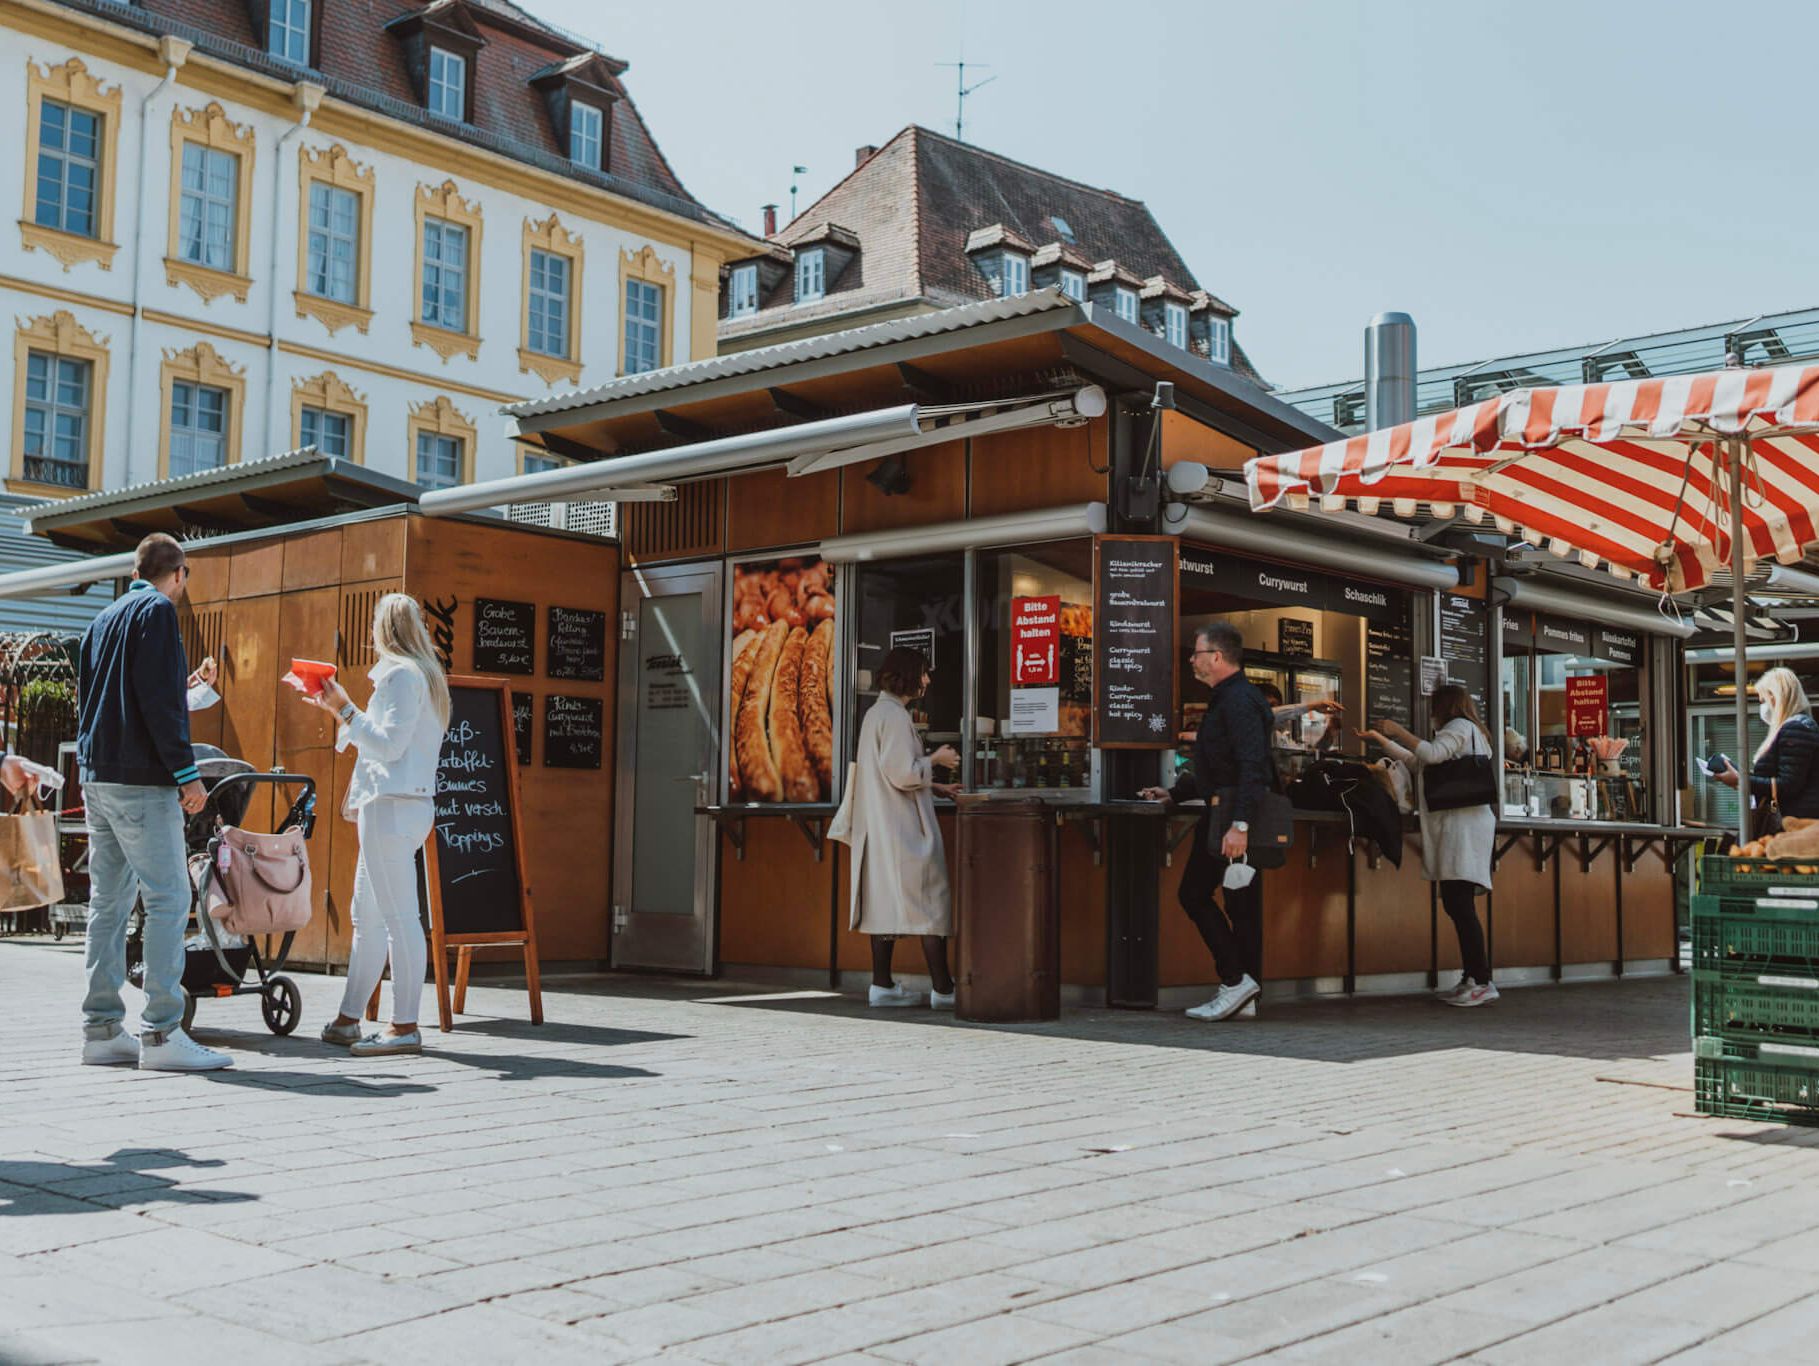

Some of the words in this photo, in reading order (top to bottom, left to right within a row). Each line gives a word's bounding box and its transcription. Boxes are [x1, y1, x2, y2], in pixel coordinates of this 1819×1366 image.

[1259, 572, 1308, 593] Currywurst
[1345, 587, 1387, 606] Schaschlik
[1024, 602, 1048, 613] Bitte
[1016, 613, 1056, 626] Abstand
[1503, 617, 1519, 631] Fries
[1020, 628, 1051, 638] halten
[1544, 624, 1569, 641] Pommes
[1569, 630, 1584, 643] frites
[1109, 646, 1151, 656] Currywurst
[1576, 679, 1597, 687] Bitte
[1570, 688, 1604, 697] Abstand
[435, 822, 504, 853] Toppings
